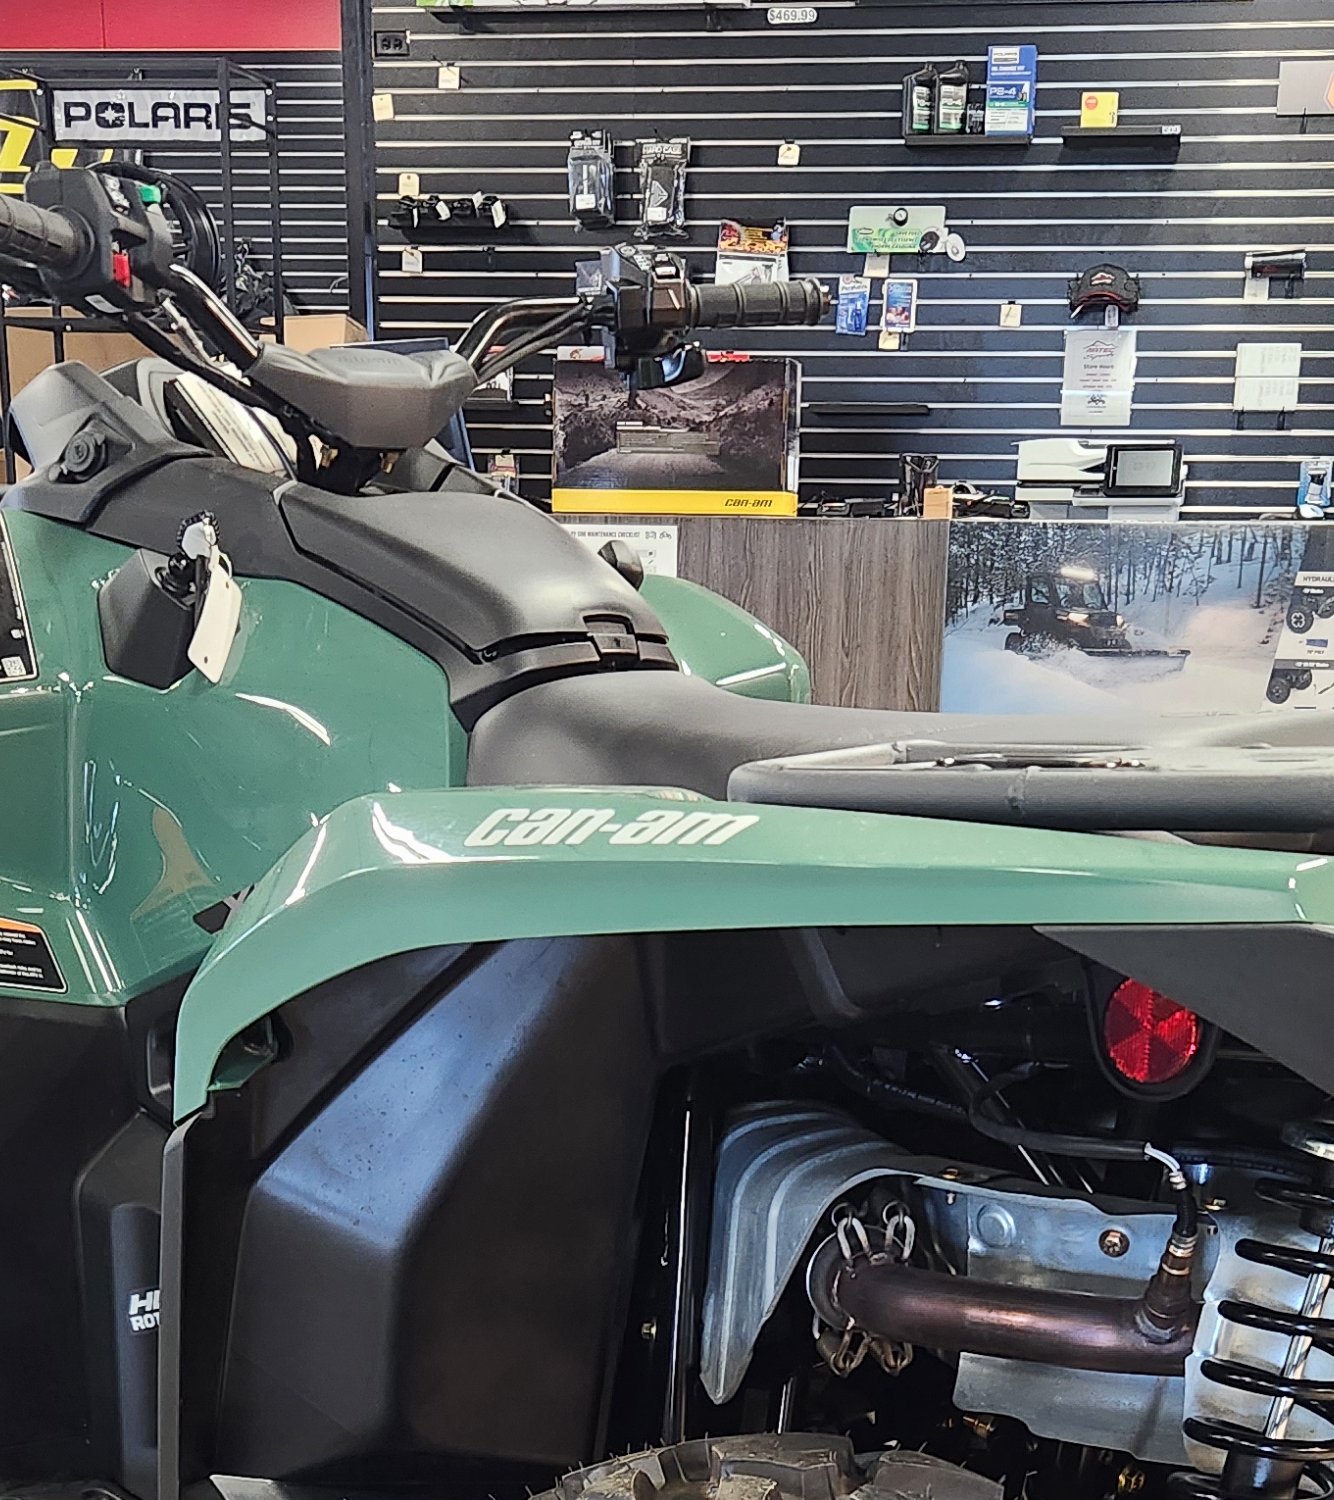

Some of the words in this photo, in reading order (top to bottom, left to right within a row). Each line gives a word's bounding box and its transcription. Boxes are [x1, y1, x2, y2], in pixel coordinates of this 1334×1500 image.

[769, 9, 815, 22] $469.99
[65, 101, 252, 129] POLARIS
[724, 498, 773, 508] can-am
[463, 808, 760, 847] can-am
